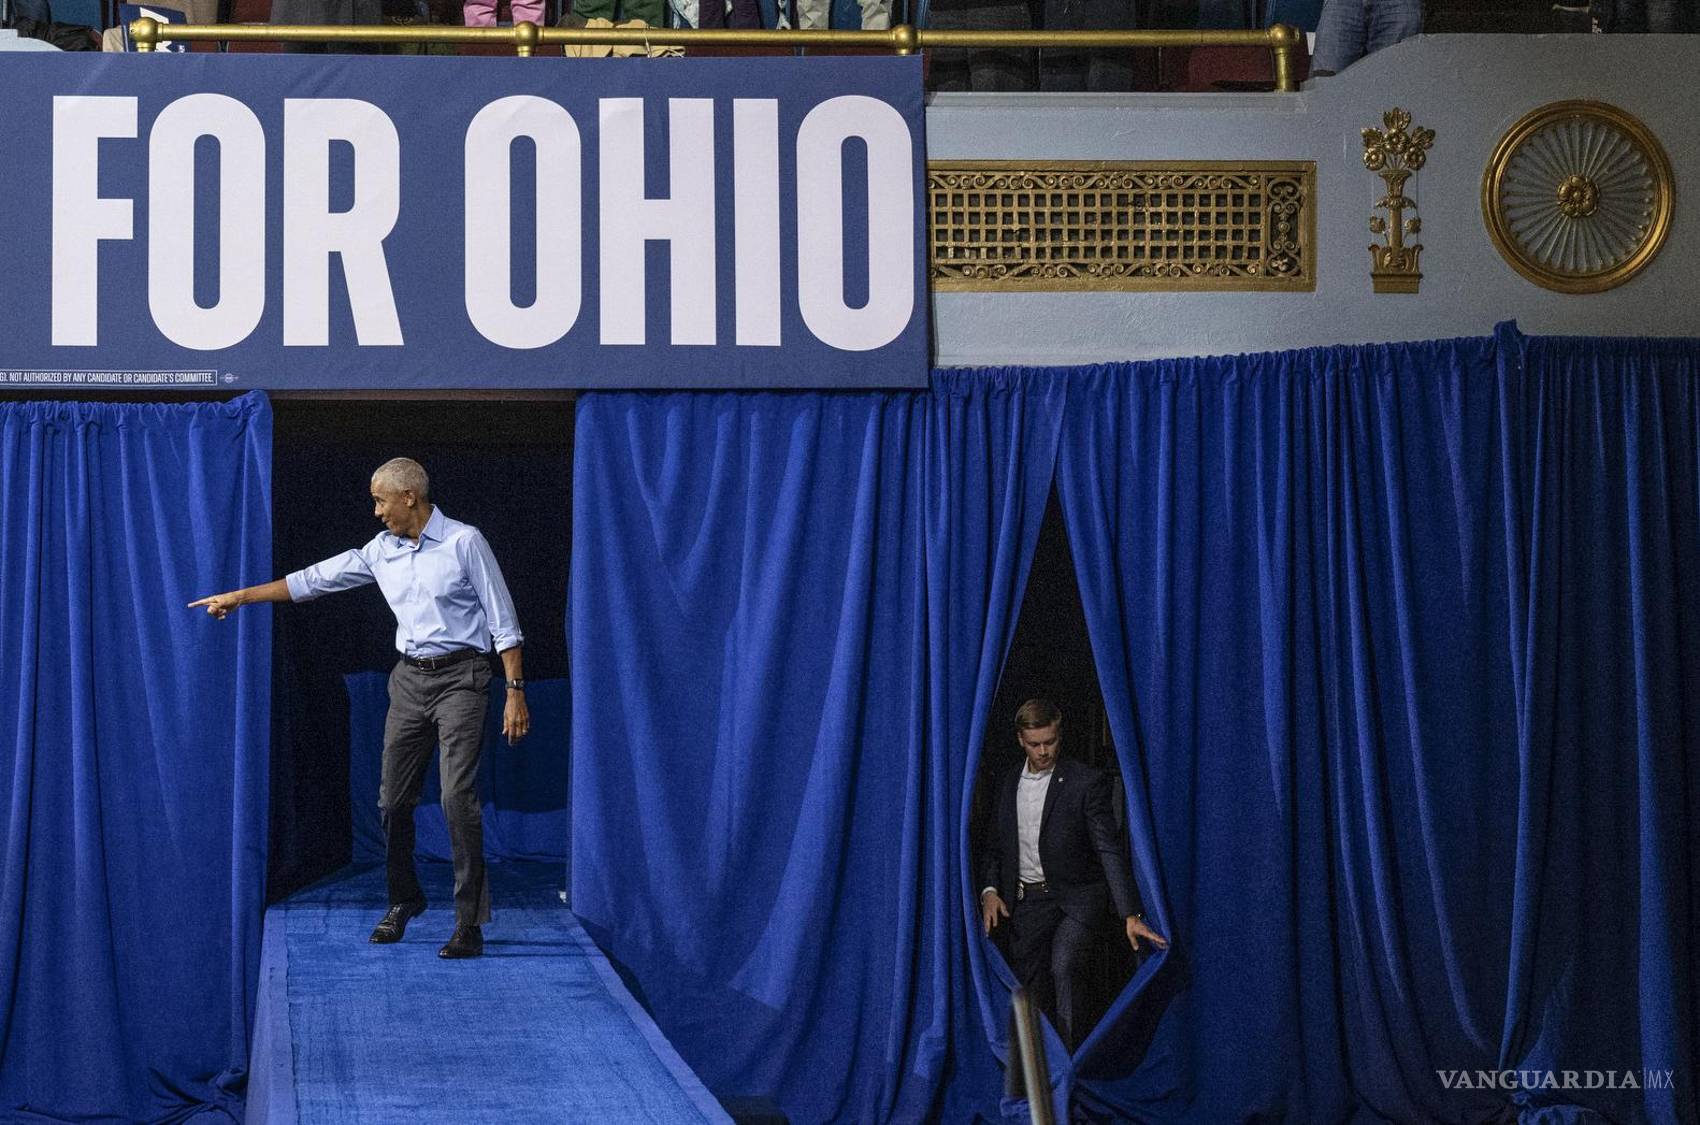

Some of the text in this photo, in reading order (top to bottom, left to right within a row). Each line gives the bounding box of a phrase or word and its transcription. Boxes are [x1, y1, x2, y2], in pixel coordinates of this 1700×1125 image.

[51, 93, 914, 352] FOR OHIO
[10, 372, 22, 382] NOT
[23, 372, 62, 382] AUTHORIZED
[63, 372, 73, 382] BY
[73, 372, 86, 382] ANY
[87, 372, 122, 383] CANDIDATE
[123, 373, 133, 383] OR
[133, 373, 174, 383] CANDIDATE'S
[175, 373, 214, 383] COMMITTEE.
